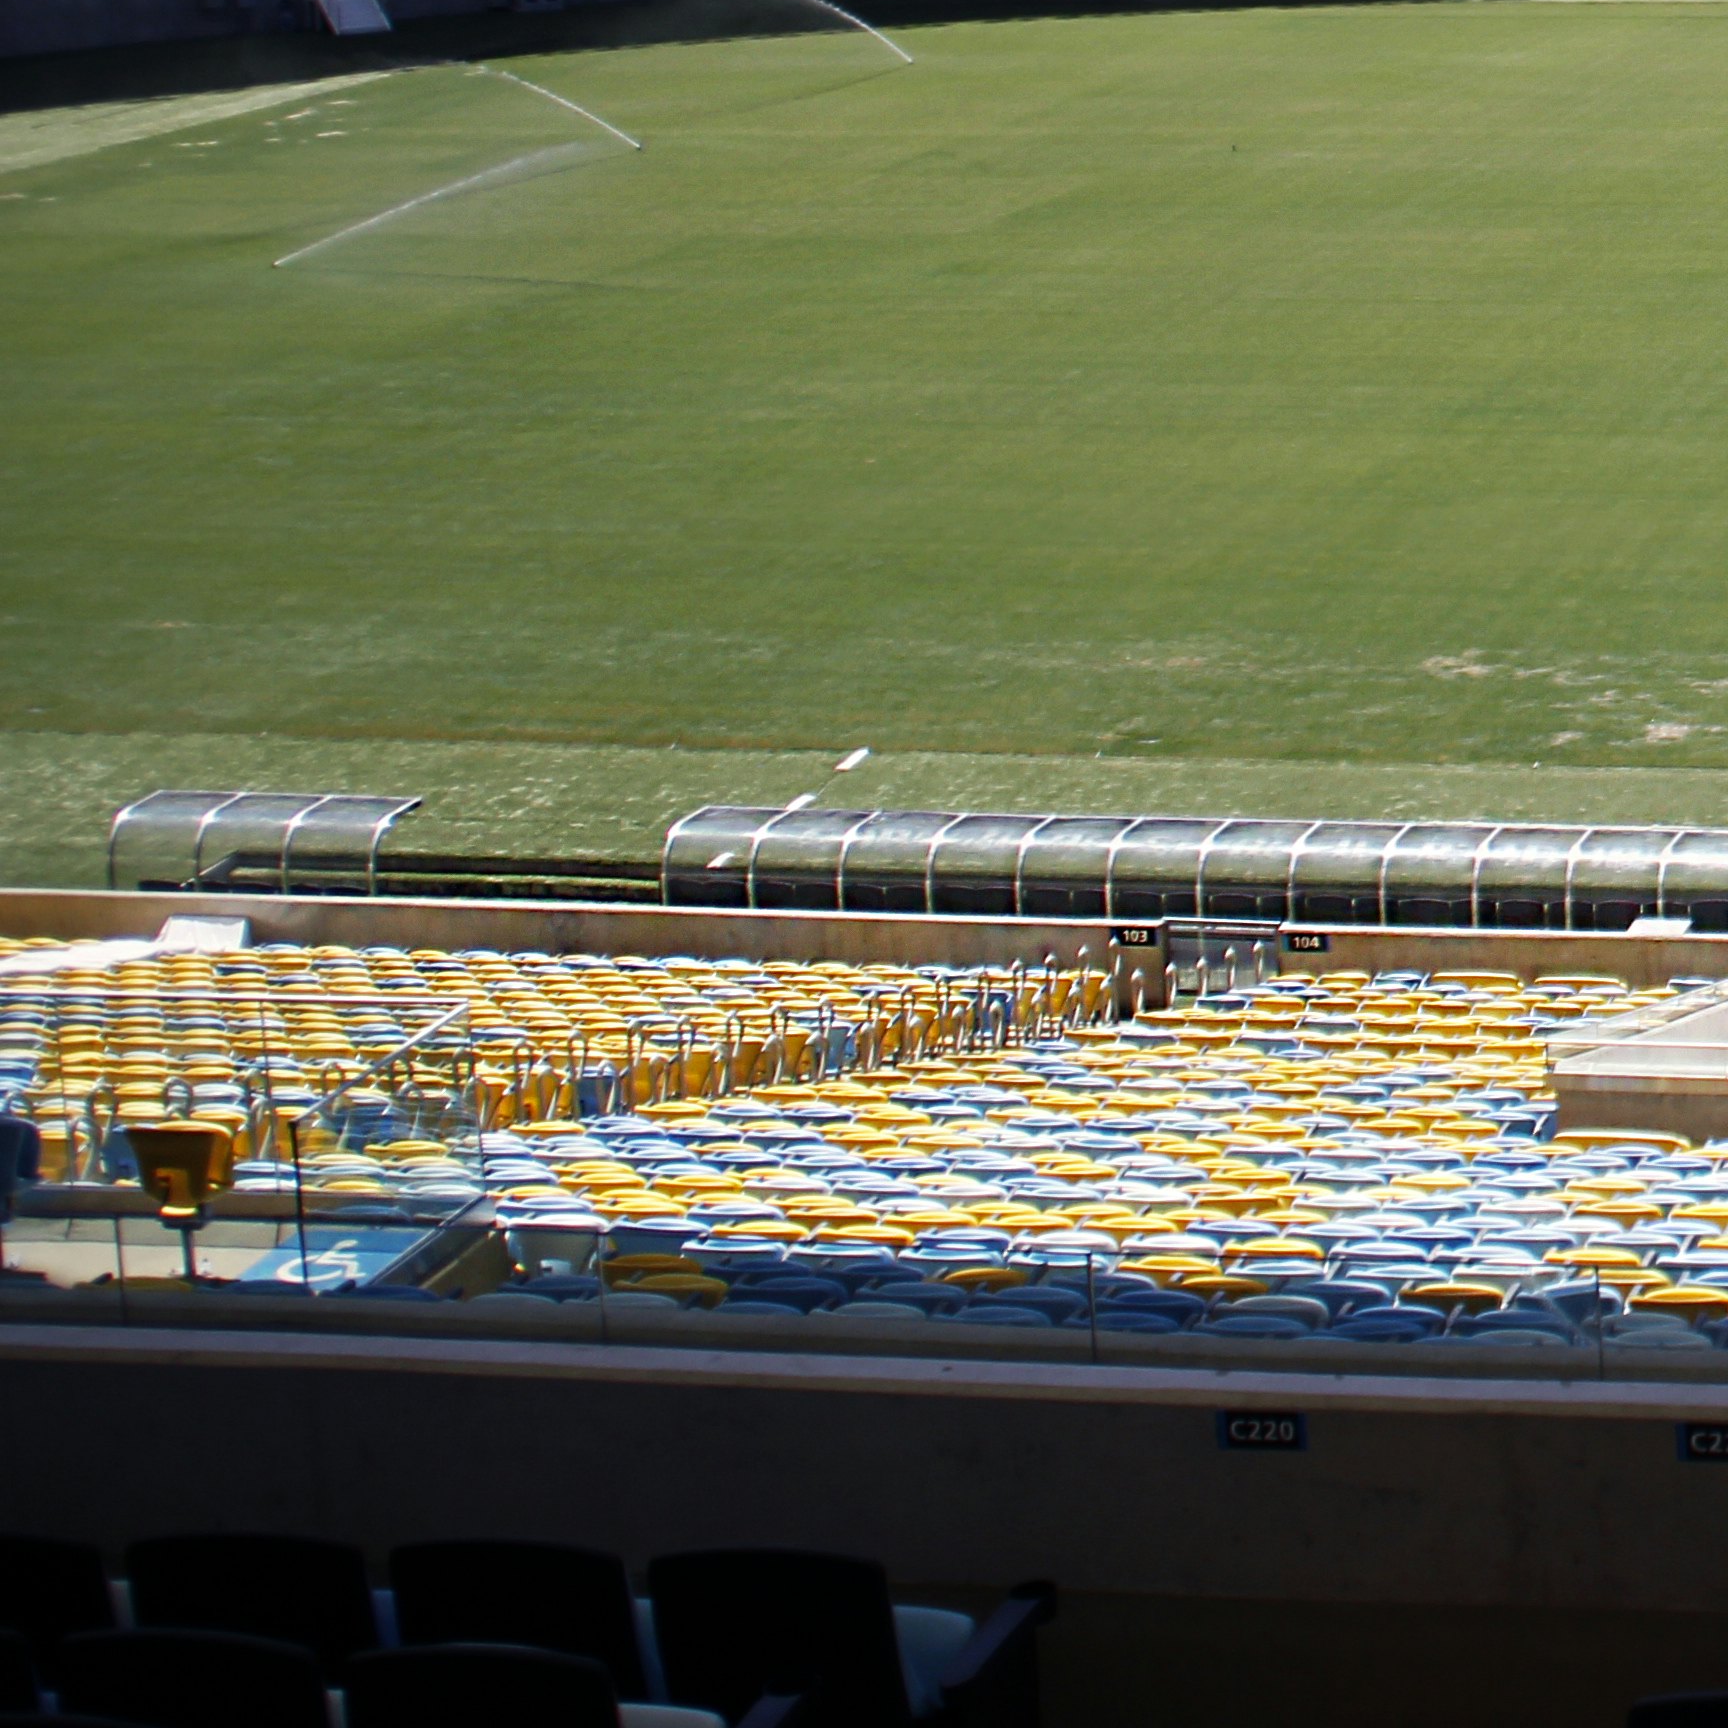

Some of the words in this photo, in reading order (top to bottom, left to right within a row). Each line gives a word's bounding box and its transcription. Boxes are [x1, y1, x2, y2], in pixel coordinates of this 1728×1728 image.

[1122, 929, 1149, 943] 103
[1292, 935, 1320, 949] 104
[1230, 1420, 1295, 1441] C220
